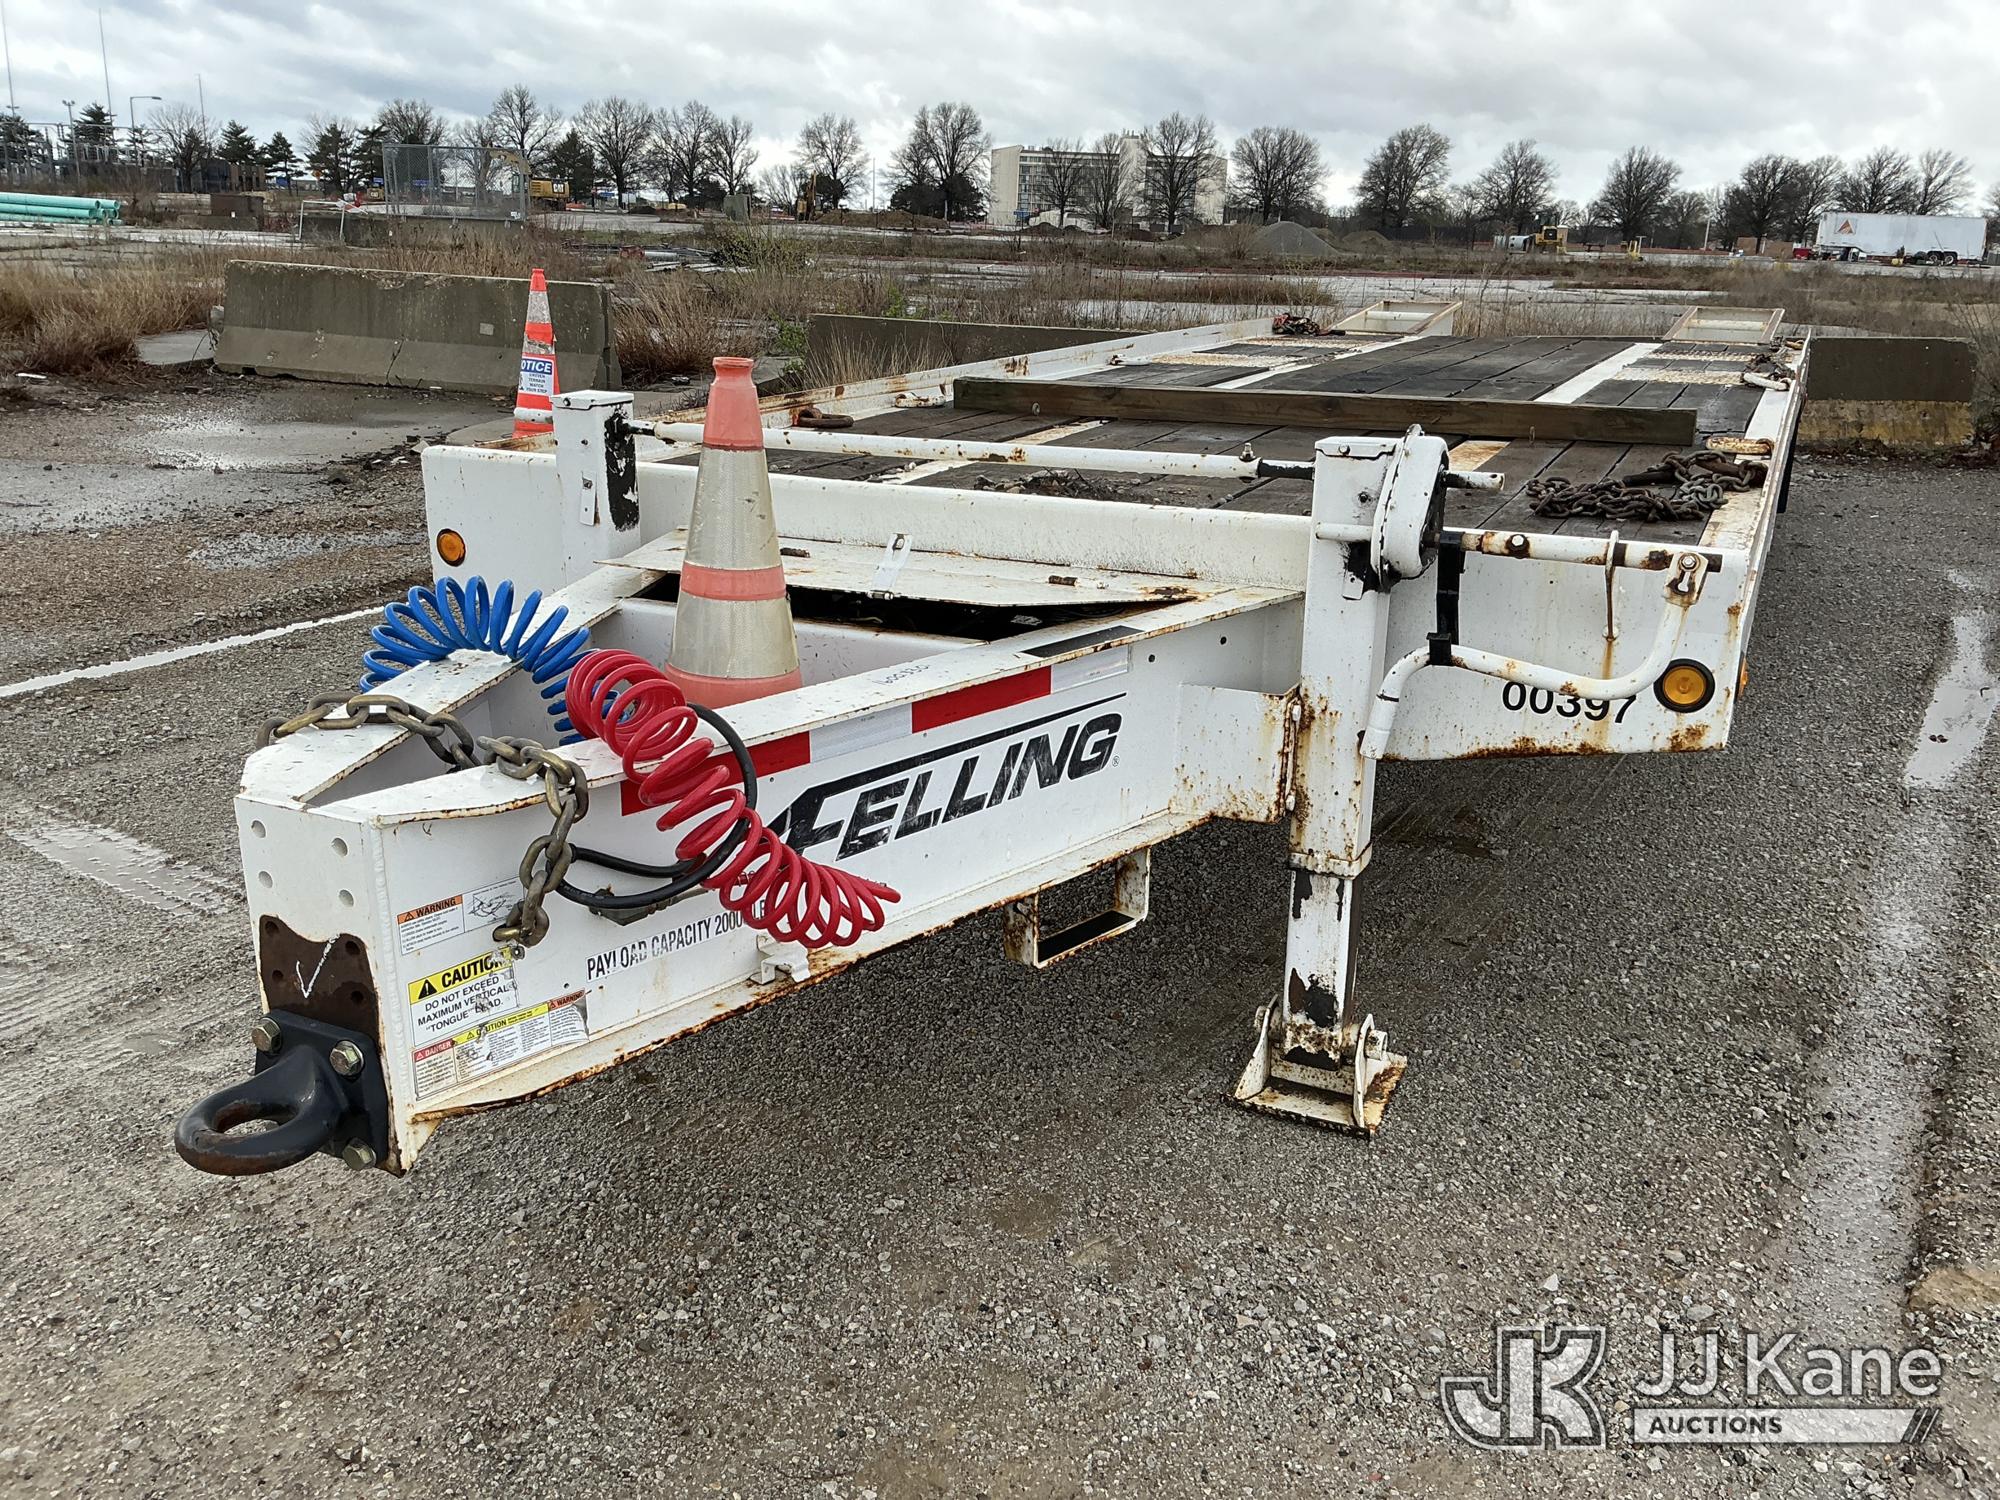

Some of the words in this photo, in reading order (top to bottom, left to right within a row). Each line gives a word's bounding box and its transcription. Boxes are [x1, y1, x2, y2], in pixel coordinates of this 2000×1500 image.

[521, 360, 552, 373] OTICE
[1502, 681, 1637, 724] 00397
[782, 711, 1123, 862] FELLING
[416, 898, 456, 917] WARNING
[651, 918, 711, 957] CAPACITY
[417, 1001, 462, 1026] MAXIMUM
[464, 984, 509, 1006] VERTICAL
[425, 1000, 439, 1012] DO
[441, 990, 461, 1005] NOT
[462, 976, 500, 996] EXCEED
[476, 1019, 507, 1036] CUTION
[424, 1041, 452, 1057] DANGER
